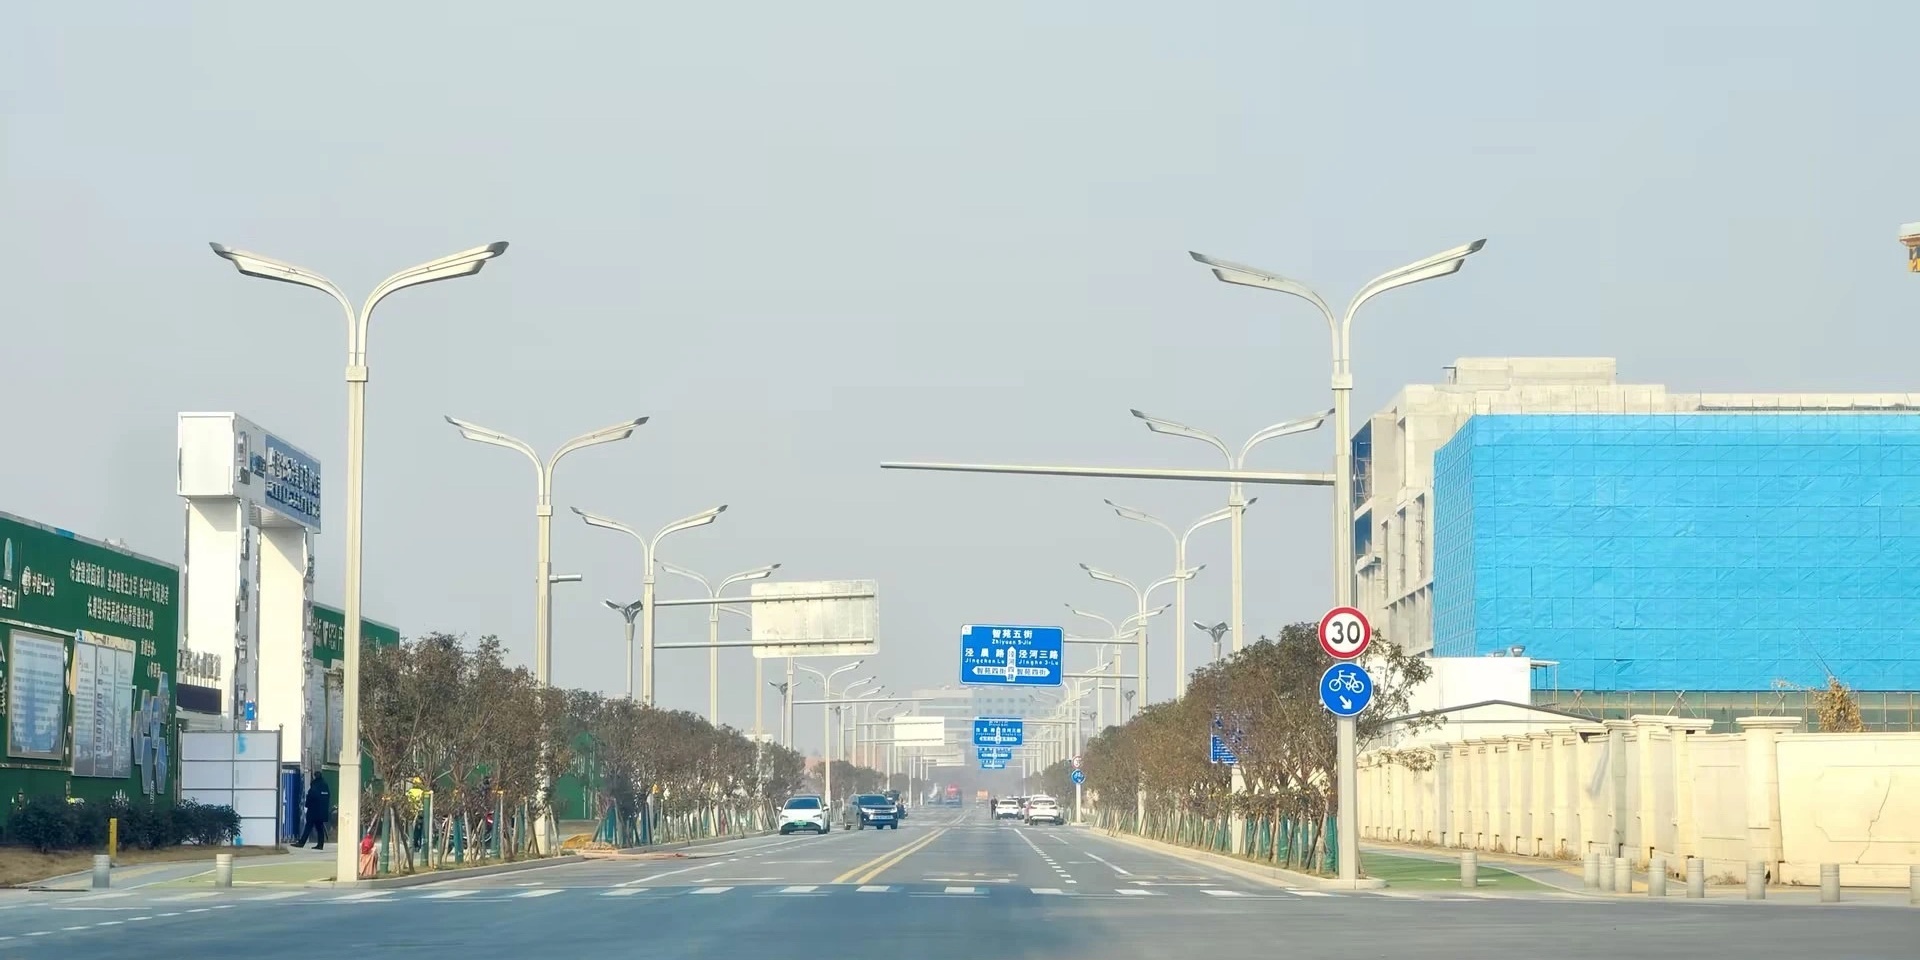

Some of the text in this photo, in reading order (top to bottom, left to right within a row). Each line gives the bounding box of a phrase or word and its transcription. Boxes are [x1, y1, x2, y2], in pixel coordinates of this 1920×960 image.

[992, 629, 1032, 639] 智苑五街
[1331, 621, 1361, 644] 30
[1018, 650, 1058, 660] 泾河三路
